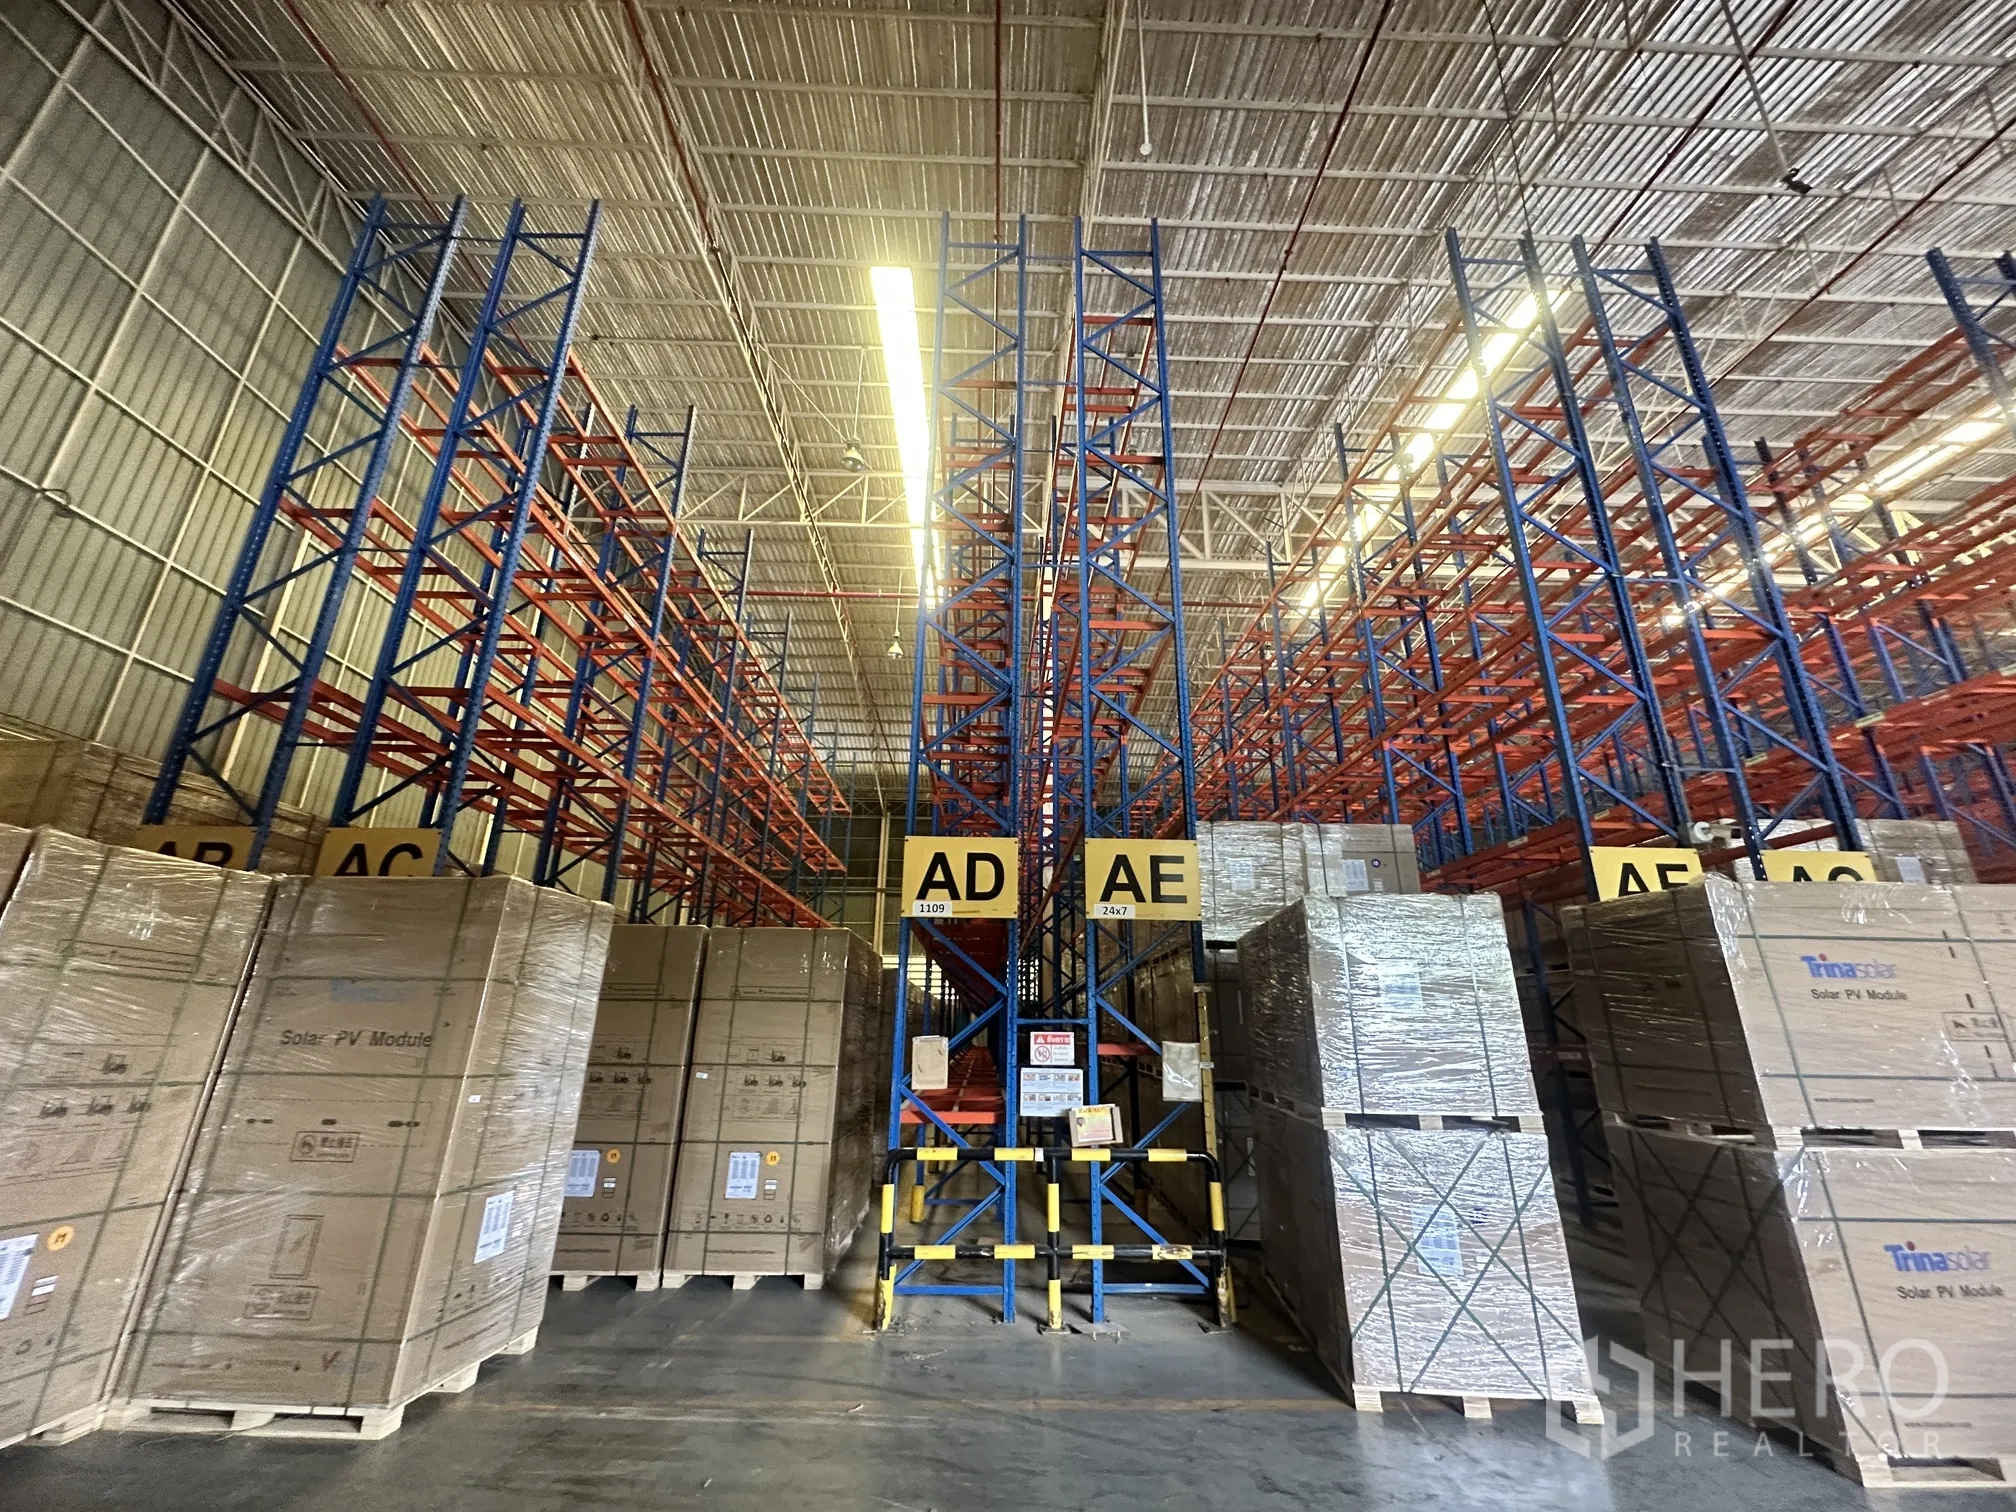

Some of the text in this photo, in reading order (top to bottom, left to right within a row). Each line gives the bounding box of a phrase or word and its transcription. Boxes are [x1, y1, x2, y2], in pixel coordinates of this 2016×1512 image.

[334, 842, 423, 877] AC
[916, 851, 1005, 901] AD
[1099, 854, 1188, 904] AE
[919, 903, 945, 914] 1109
[1102, 906, 1128, 916] 24x7
[1800, 953, 1897, 979] Trinasolar
[1811, 988, 1908, 1000] Solar PV Module
[280, 1029, 433, 1048] Solar PV Module
[1883, 1241, 1991, 1272] Trinasolar
[1896, 1284, 2004, 1299] Solar PV Module
